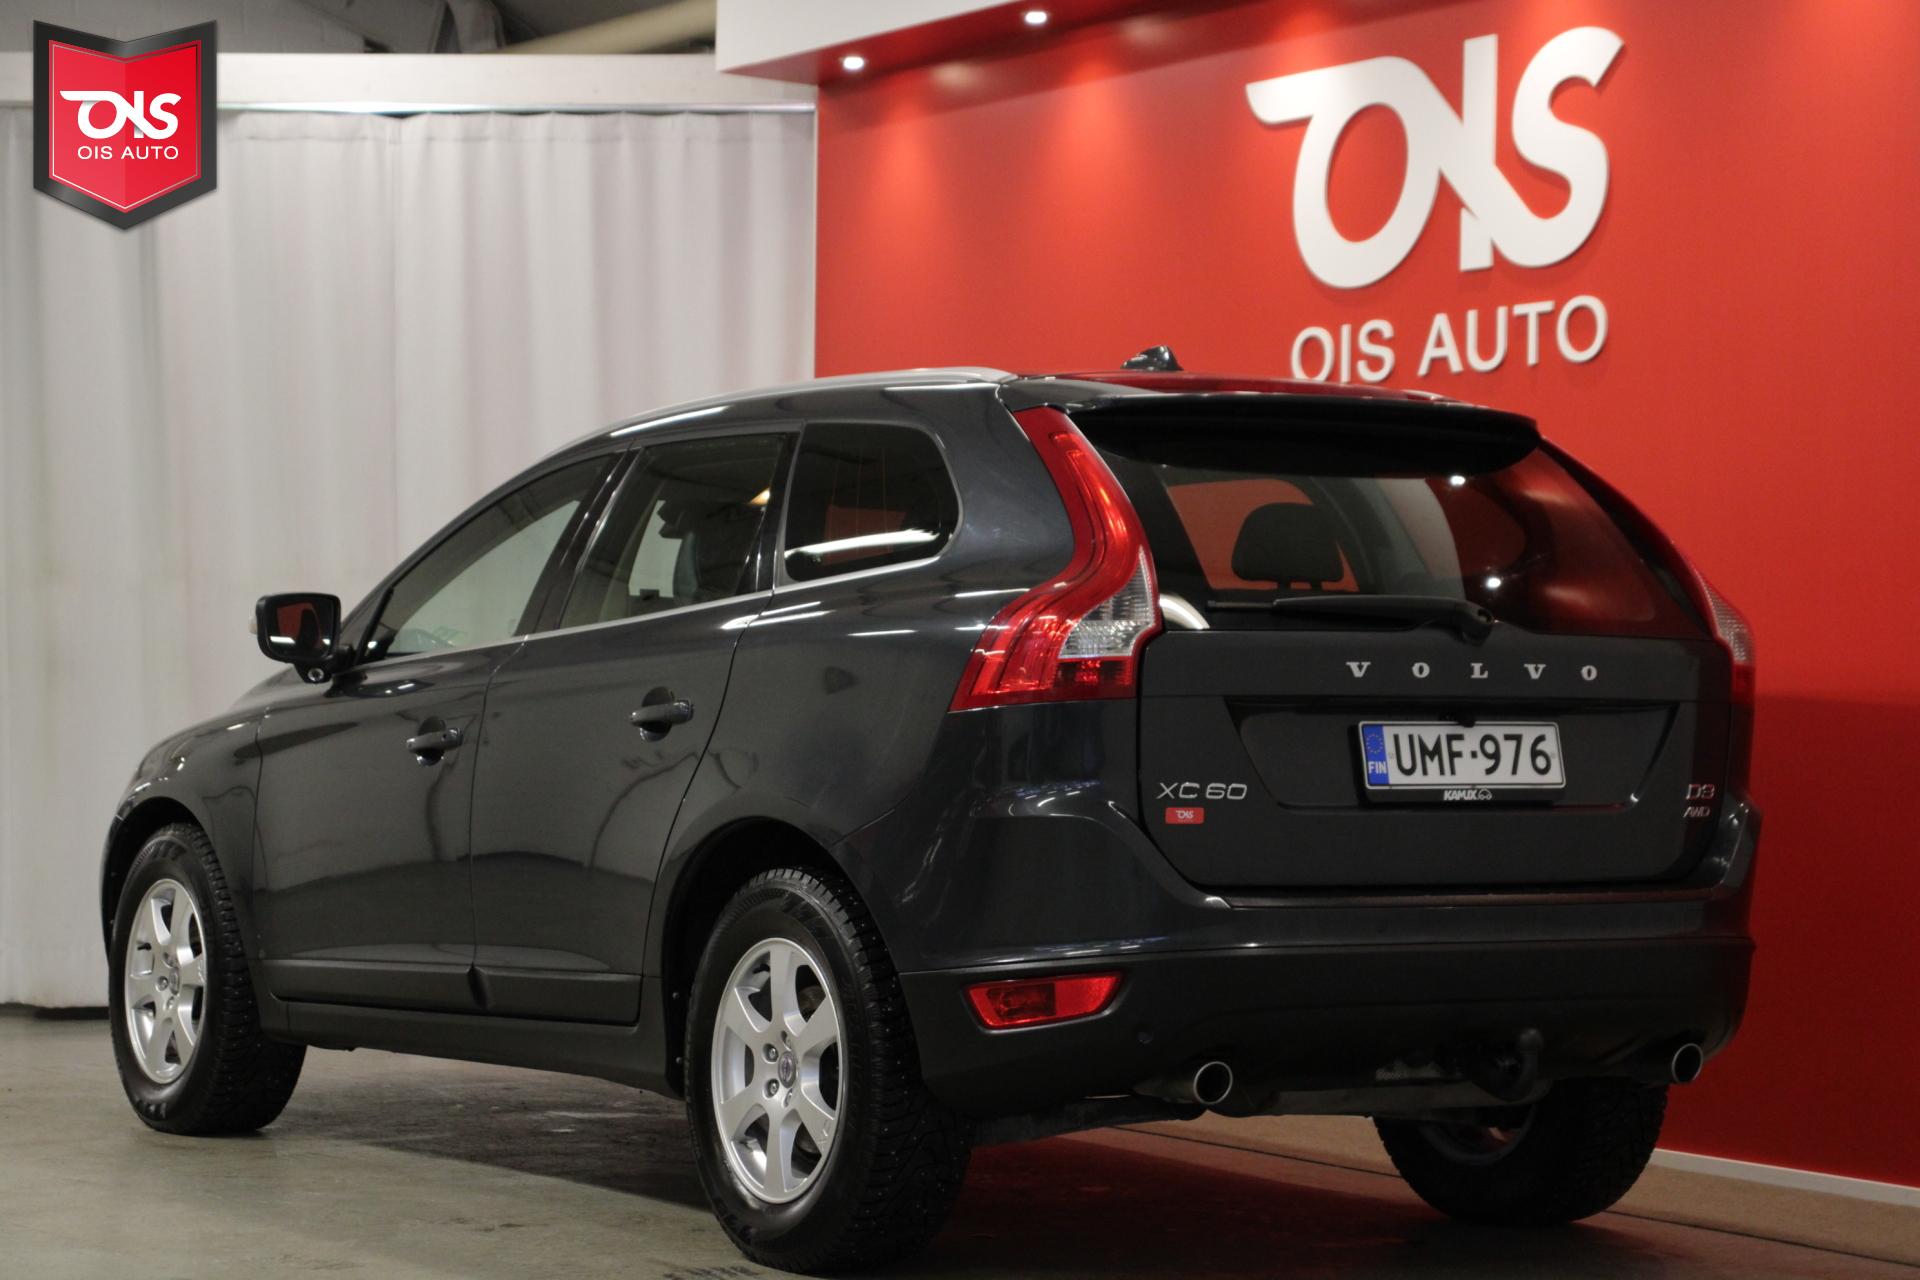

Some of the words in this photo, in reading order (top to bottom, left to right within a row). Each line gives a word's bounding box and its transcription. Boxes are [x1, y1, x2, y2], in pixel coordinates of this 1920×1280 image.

[1246, 26, 1625, 290] OIS
[1291, 318, 1396, 384] OIS
[1417, 295, 1608, 377] AUTO
[1345, 661, 1598, 681] VOLVO
[1368, 761, 1387, 774] FIN
[1393, 733, 1552, 777] UMF-976
[1685, 783, 1715, 800] D3
